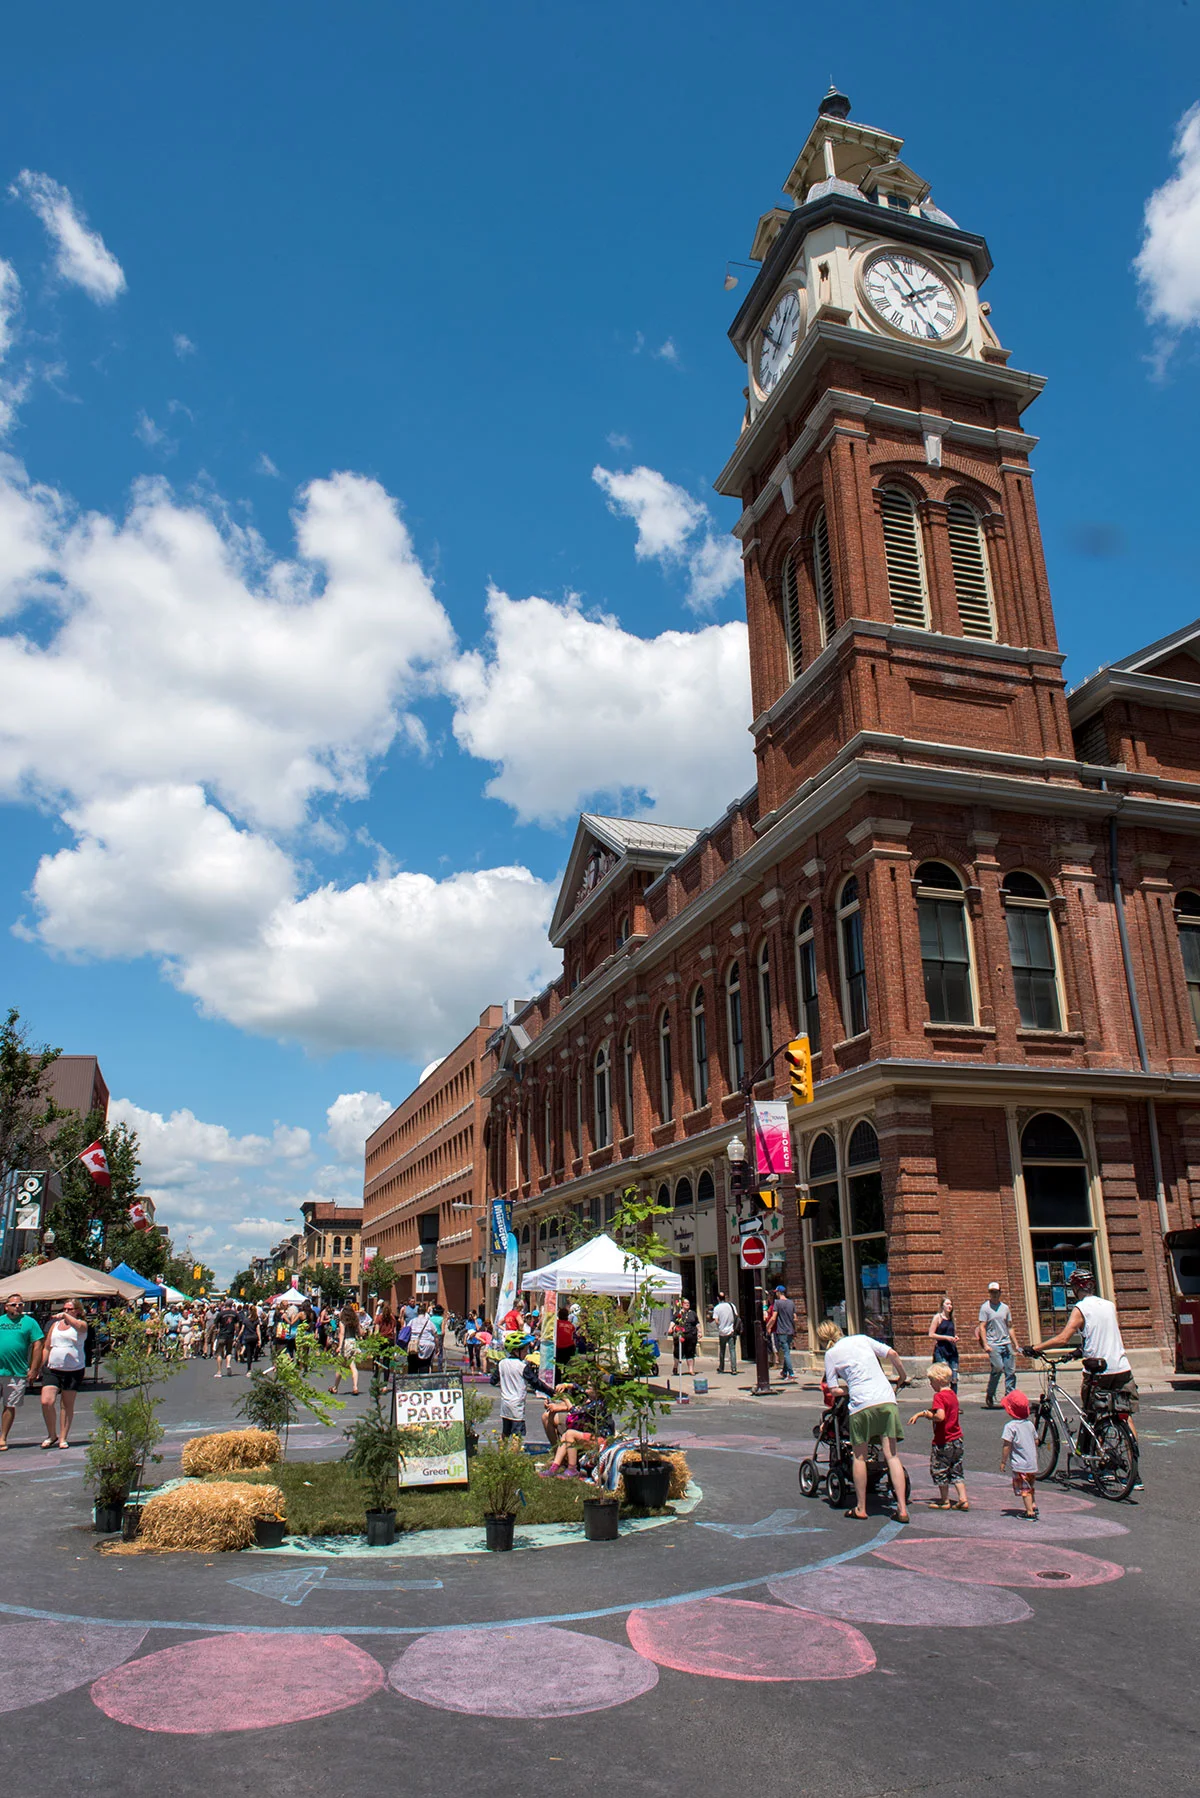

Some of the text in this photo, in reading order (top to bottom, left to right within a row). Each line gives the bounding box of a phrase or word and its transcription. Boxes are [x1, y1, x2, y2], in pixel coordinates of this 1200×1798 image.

[17, 1177, 40, 1205] 50
[397, 1391, 462, 1407] POP UP
[407, 1406, 454, 1422] PARK
